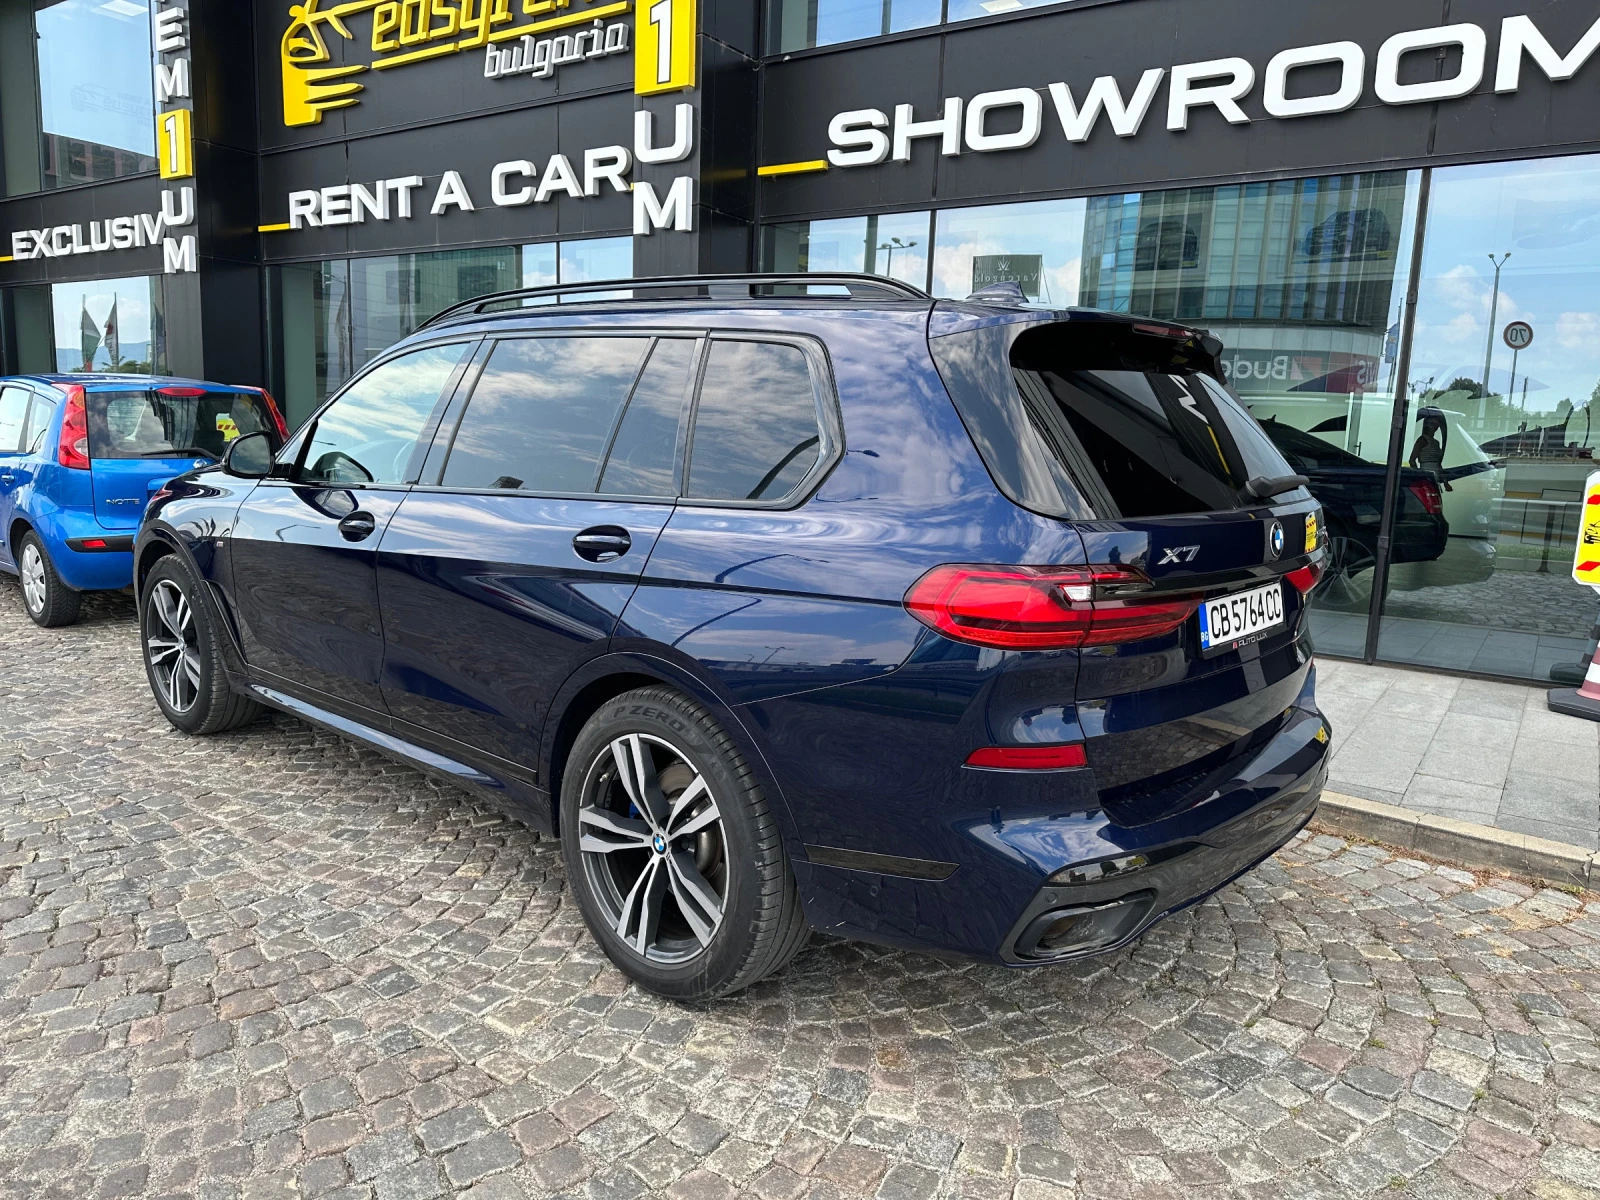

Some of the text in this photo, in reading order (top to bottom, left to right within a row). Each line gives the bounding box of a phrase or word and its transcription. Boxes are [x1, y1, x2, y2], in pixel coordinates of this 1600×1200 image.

[484, 18, 630, 79] bulgaria
[828, 15, 1600, 167] SHOWROOM
[289, 145, 632, 229] RENT A CAR
[1157, 545, 1200, 565] X7
[614, 705, 685, 733] P ZERO
